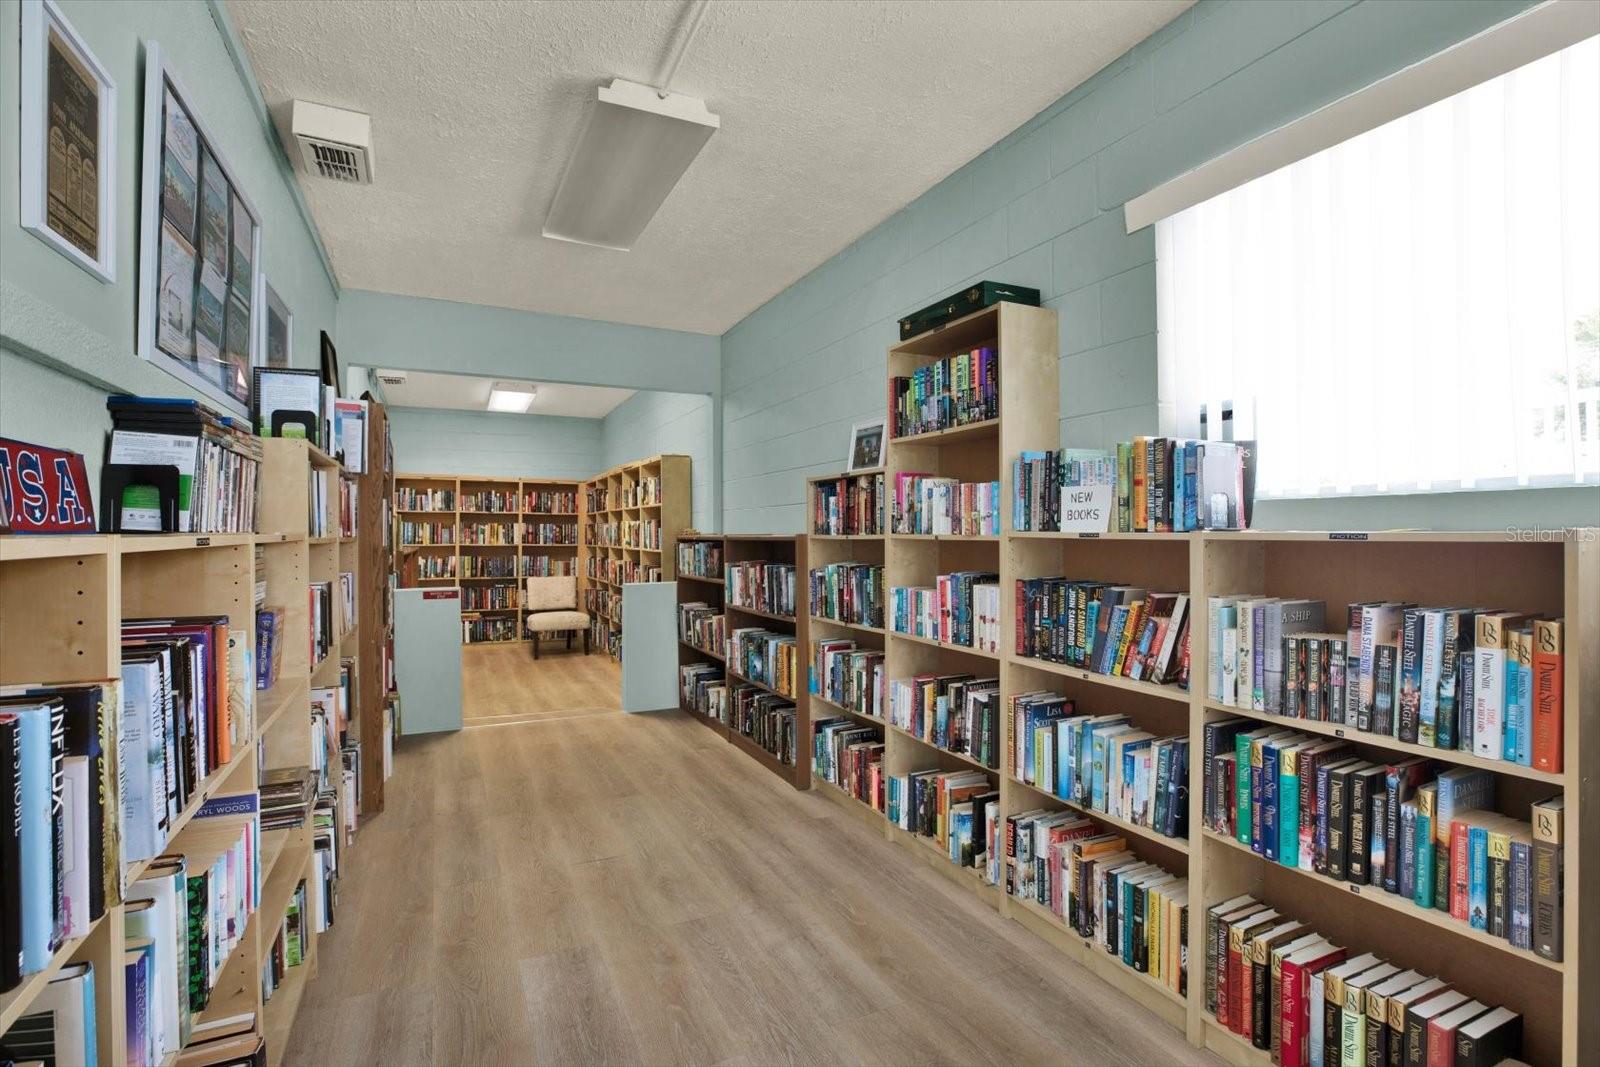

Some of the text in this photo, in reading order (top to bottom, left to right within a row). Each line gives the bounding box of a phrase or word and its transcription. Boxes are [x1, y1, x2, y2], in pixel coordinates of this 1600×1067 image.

[1066, 508, 1100, 521] BOOKS
[1070, 491, 1094, 503] NEW
[1281, 609, 1312, 623] A SHIP
[1362, 616, 1373, 636] DANA
[1403, 614, 1417, 671] DANIELLE STEEL
[1444, 616, 1454, 676] DANIELLE STEEL
[1481, 652, 1495, 690] DANIELLE STEEL
[1539, 661, 1558, 692] DANIELLE
[1402, 696, 1415, 728] MAGIC
[1539, 693, 1558, 716] STEEL
[51, 705, 65, 814] INFLUX
[216, 803, 251, 815] WOODS
[1330, 779, 1343, 819] DANIELLE STEEL
[1386, 788, 1397, 819] DANIELLE
[1386, 819, 1397, 839] STEEL
[1538, 847, 1555, 897] DANIELLE STEEL
[1538, 901, 1555, 937] ECHOES
[1283, 972, 1294, 1014] DANIELLE STEEL
[1344, 1013, 1358, 1060] DANIELLE STEEL
[1367, 1019, 1381, 1067] DANIELLE STEEL
[1409, 1022, 1423, 1064] DANIELLE STEEL
